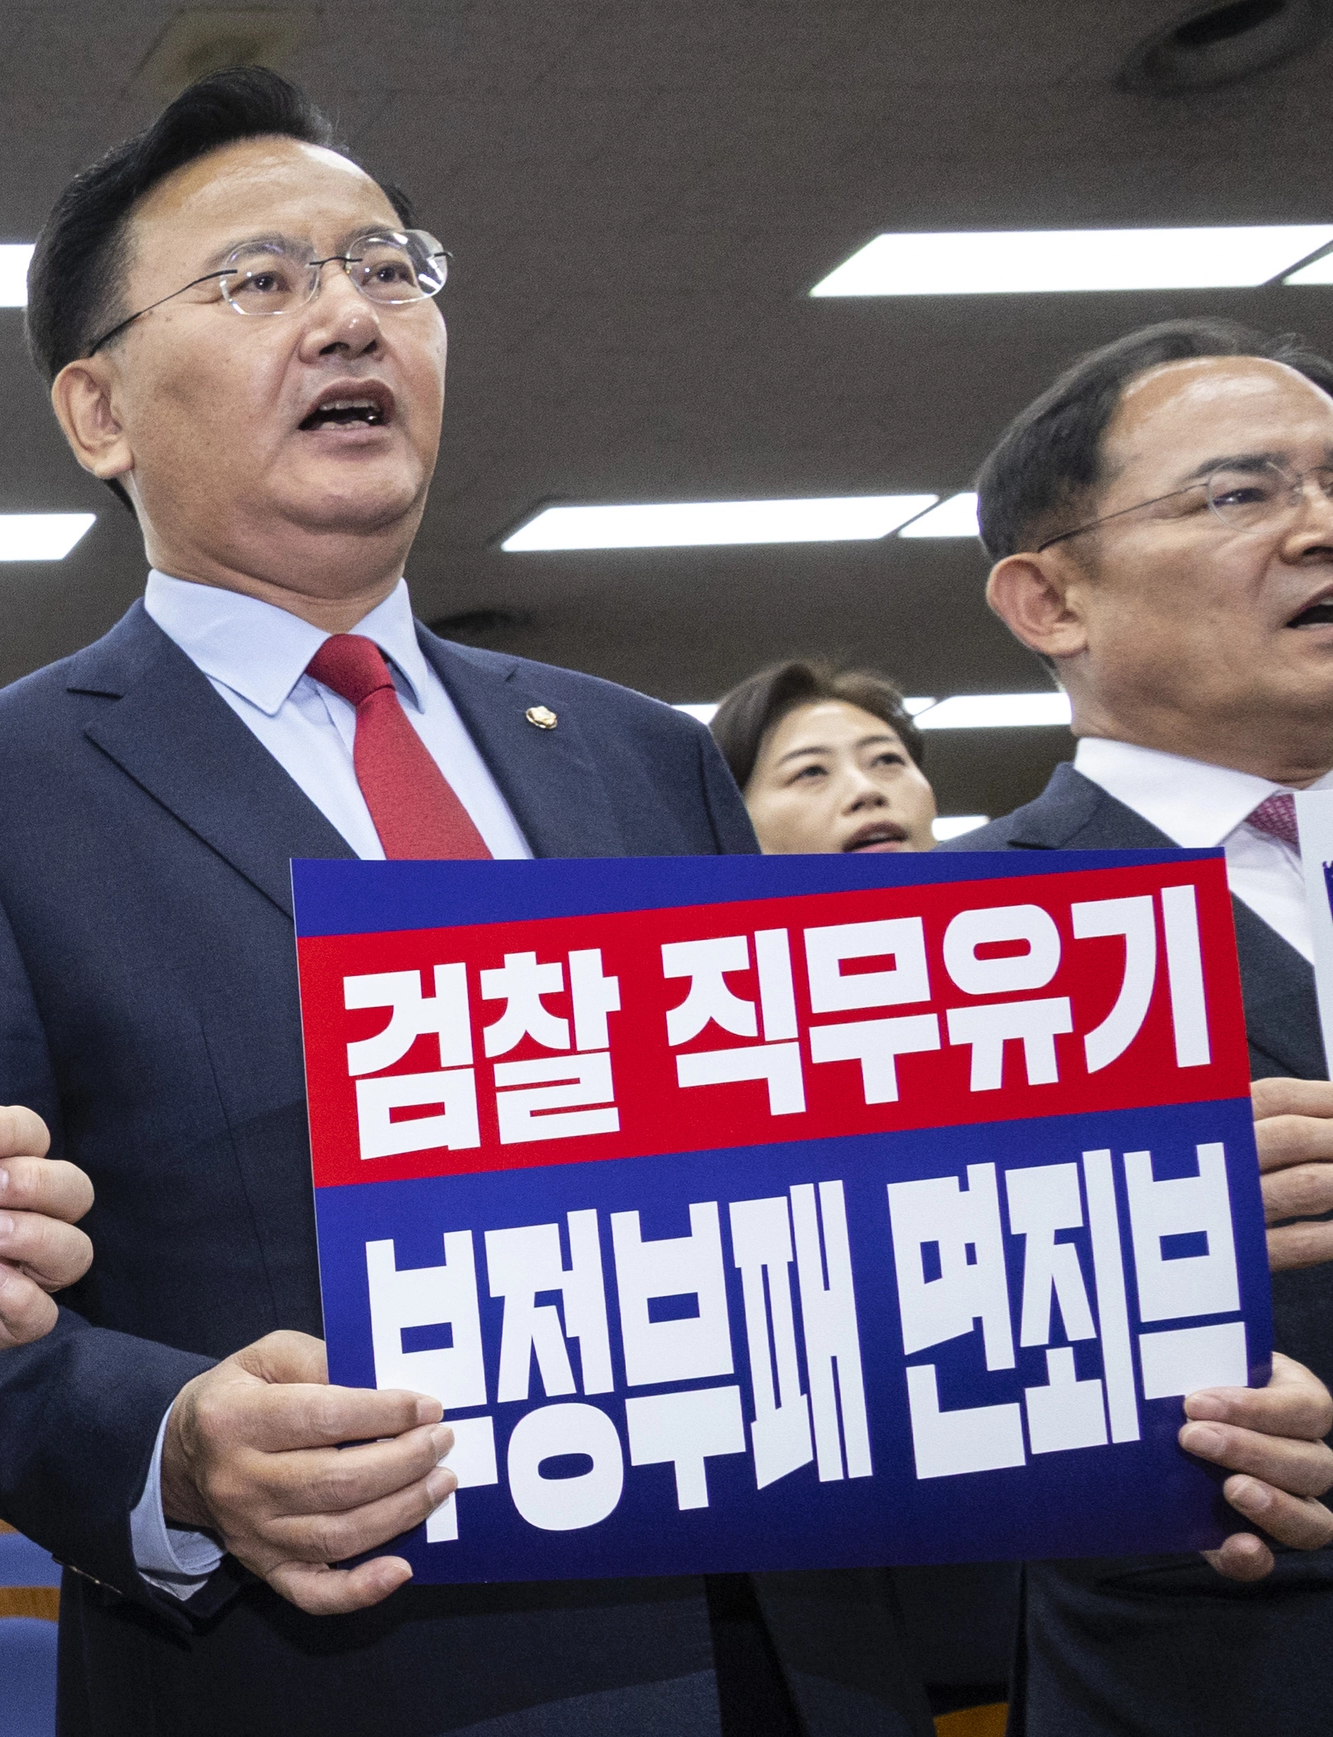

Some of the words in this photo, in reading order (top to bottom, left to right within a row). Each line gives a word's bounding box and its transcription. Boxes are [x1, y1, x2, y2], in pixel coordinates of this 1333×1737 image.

[342, 948, 622, 1160] 검찰
[660, 883, 1213, 1116] 직무유기
[364, 1179, 874, 1543] 부정부패
[886, 1141, 1249, 1480] 면죄부
